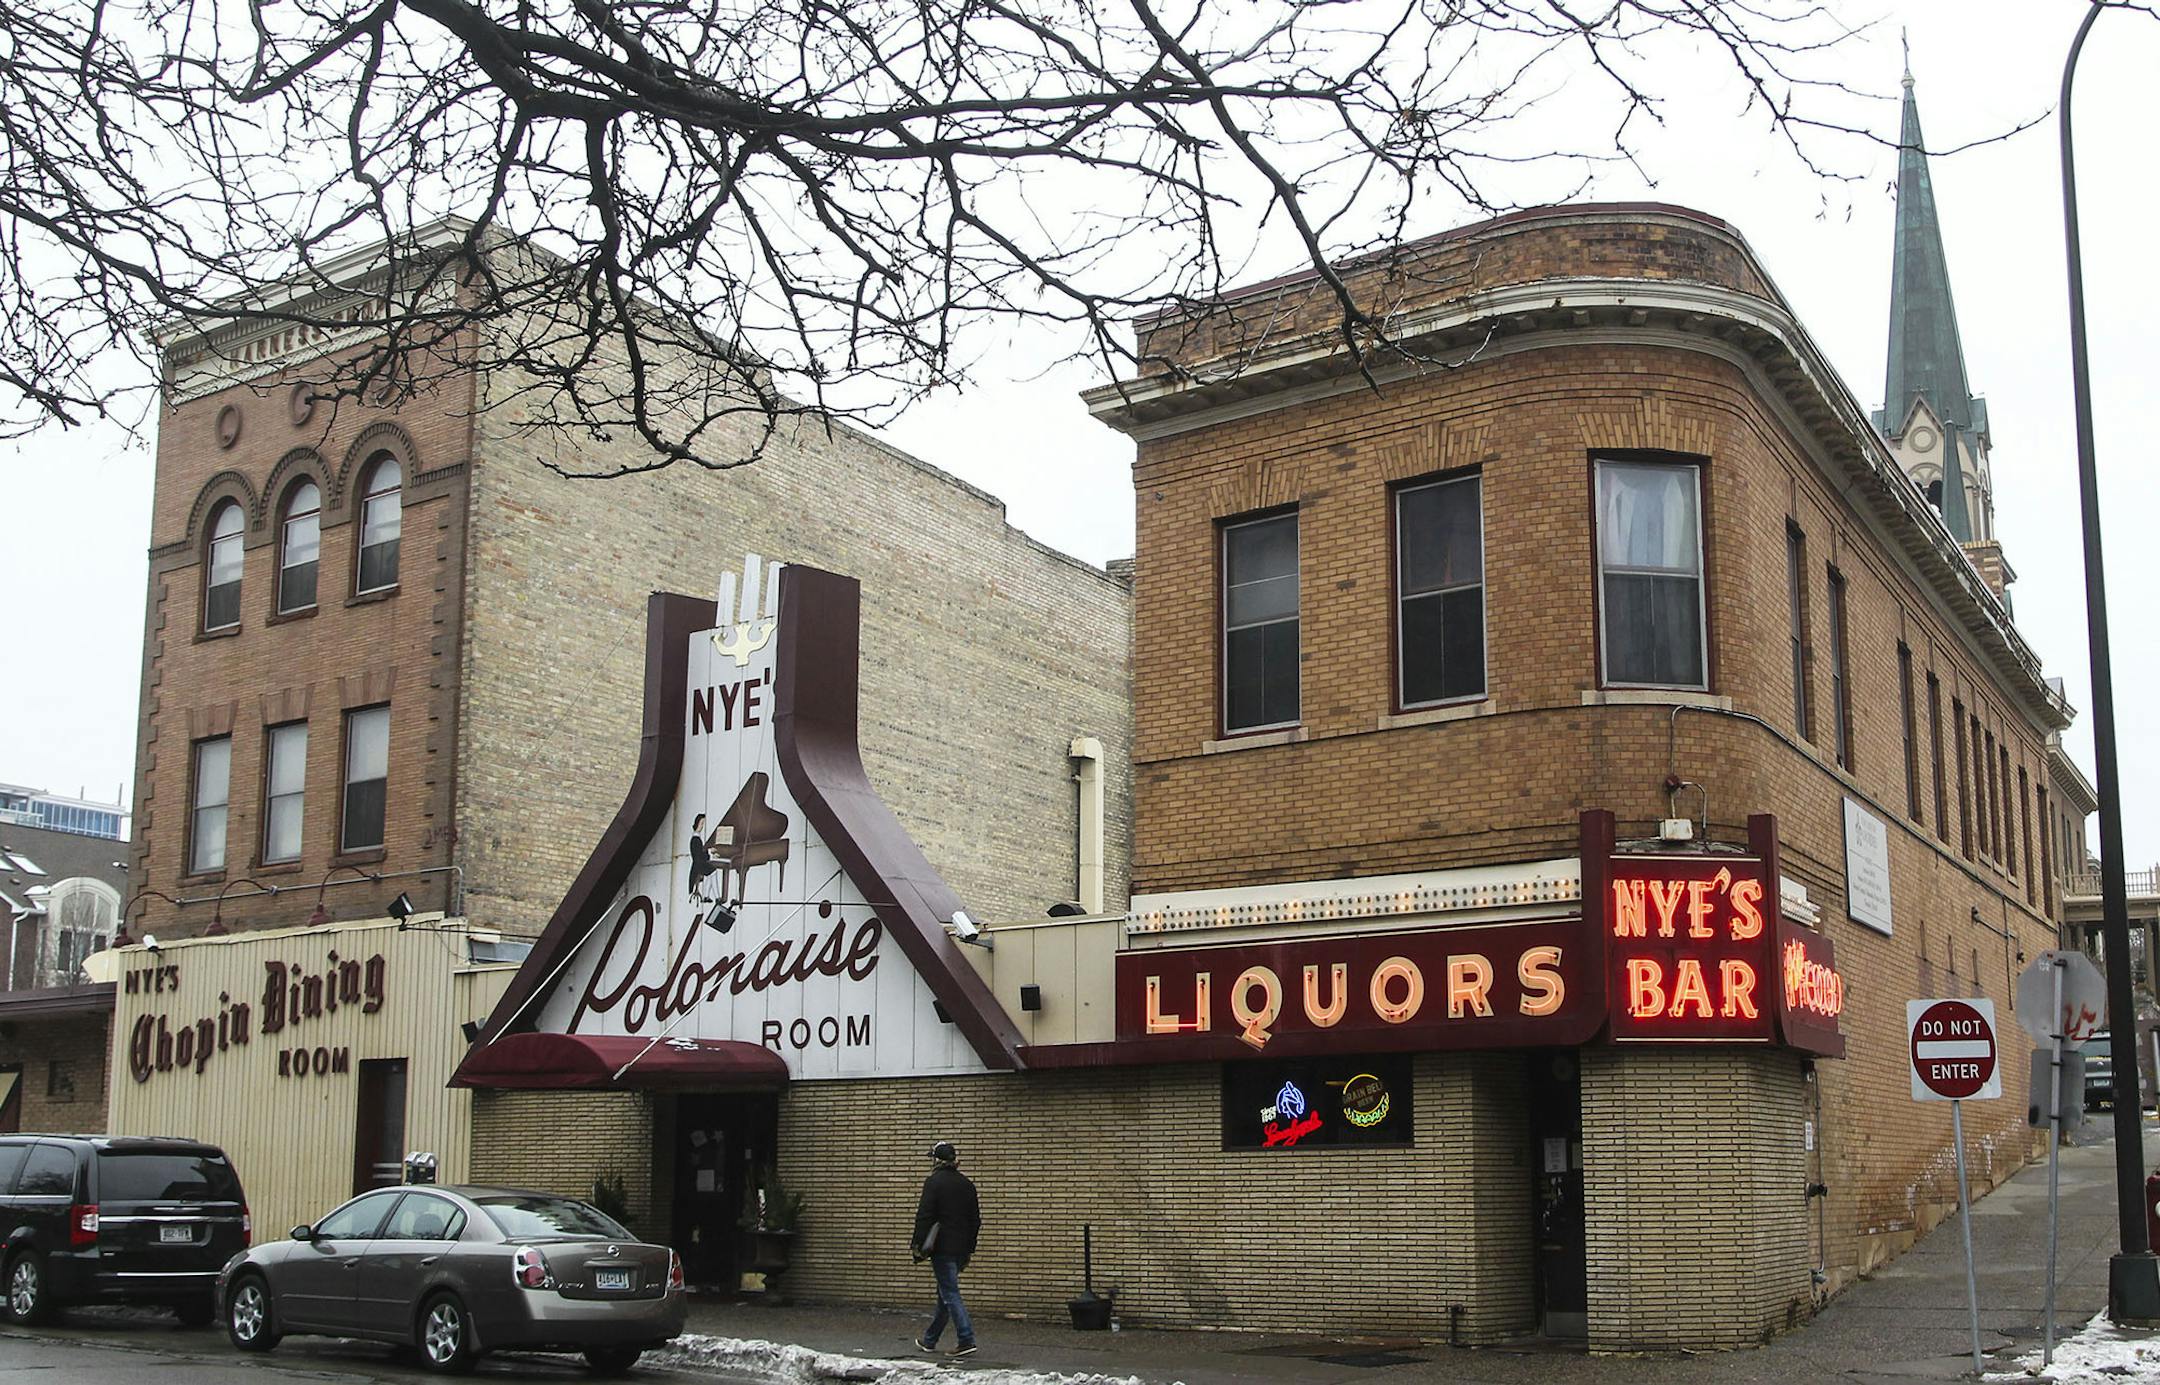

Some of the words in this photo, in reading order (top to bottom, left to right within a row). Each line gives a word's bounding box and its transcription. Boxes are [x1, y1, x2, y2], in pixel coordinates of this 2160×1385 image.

[692, 667, 771, 736] NYE'
[1612, 866, 1763, 940] NYE'S
[125, 964, 179, 994] NYE'S
[567, 895, 883, 1034] Polonaise
[1626, 959, 1759, 1019] BAR
[130, 991, 250, 1084] Chopin
[261, 950, 385, 1034] Dining
[1146, 945, 1566, 1051] LIQUORS
[1922, 1020, 1944, 1036] DO
[1950, 1020, 1981, 1036] NOT
[279, 1047, 349, 1078] ROOM
[762, 1015, 871, 1050] ROOM
[1931, 1064, 1980, 1080] ENTER
